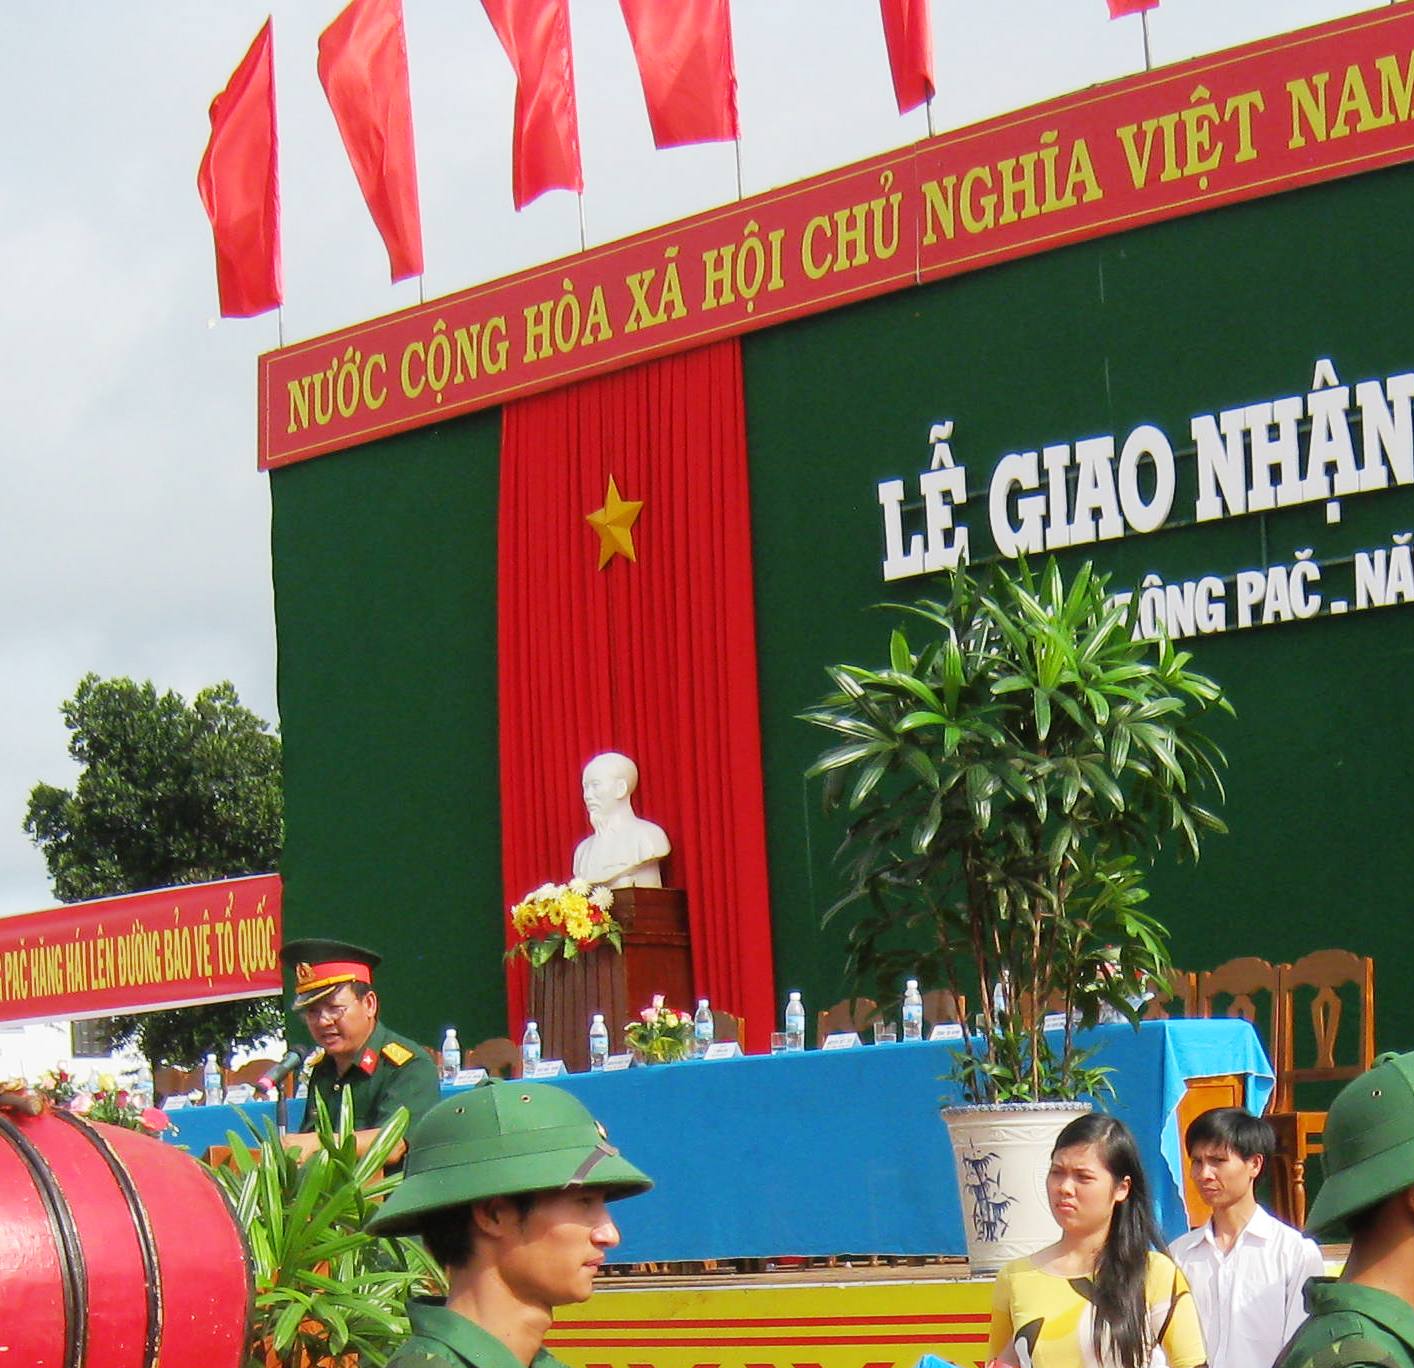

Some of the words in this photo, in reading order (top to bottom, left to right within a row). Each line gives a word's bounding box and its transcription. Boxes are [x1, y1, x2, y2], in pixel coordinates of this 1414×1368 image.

[286, 346, 387, 433] NƯỚC
[401, 319, 509, 404] CỘNG
[524, 279, 613, 364] HÒA
[625, 246, 687, 333] XÃ
[703, 220, 785, 313] HỘI
[802, 172, 903, 280] CHỦ
[921, 131, 1104, 246] NGHĨA
[1116, 85, 1265, 190] VIỆT
[878, 420, 970, 582] LỄ
[988, 425, 1176, 558] GIAO
[65, 927, 88, 993] HÁI
[90, 923, 116, 990] LÊN
[118, 918, 163, 987] ĐƯỜNG
[164, 906, 192, 980] BẢO
[194, 908, 213, 988] VỆ
[215, 890, 236, 976] TỔ
[238, 895, 277, 982] QUỐC
